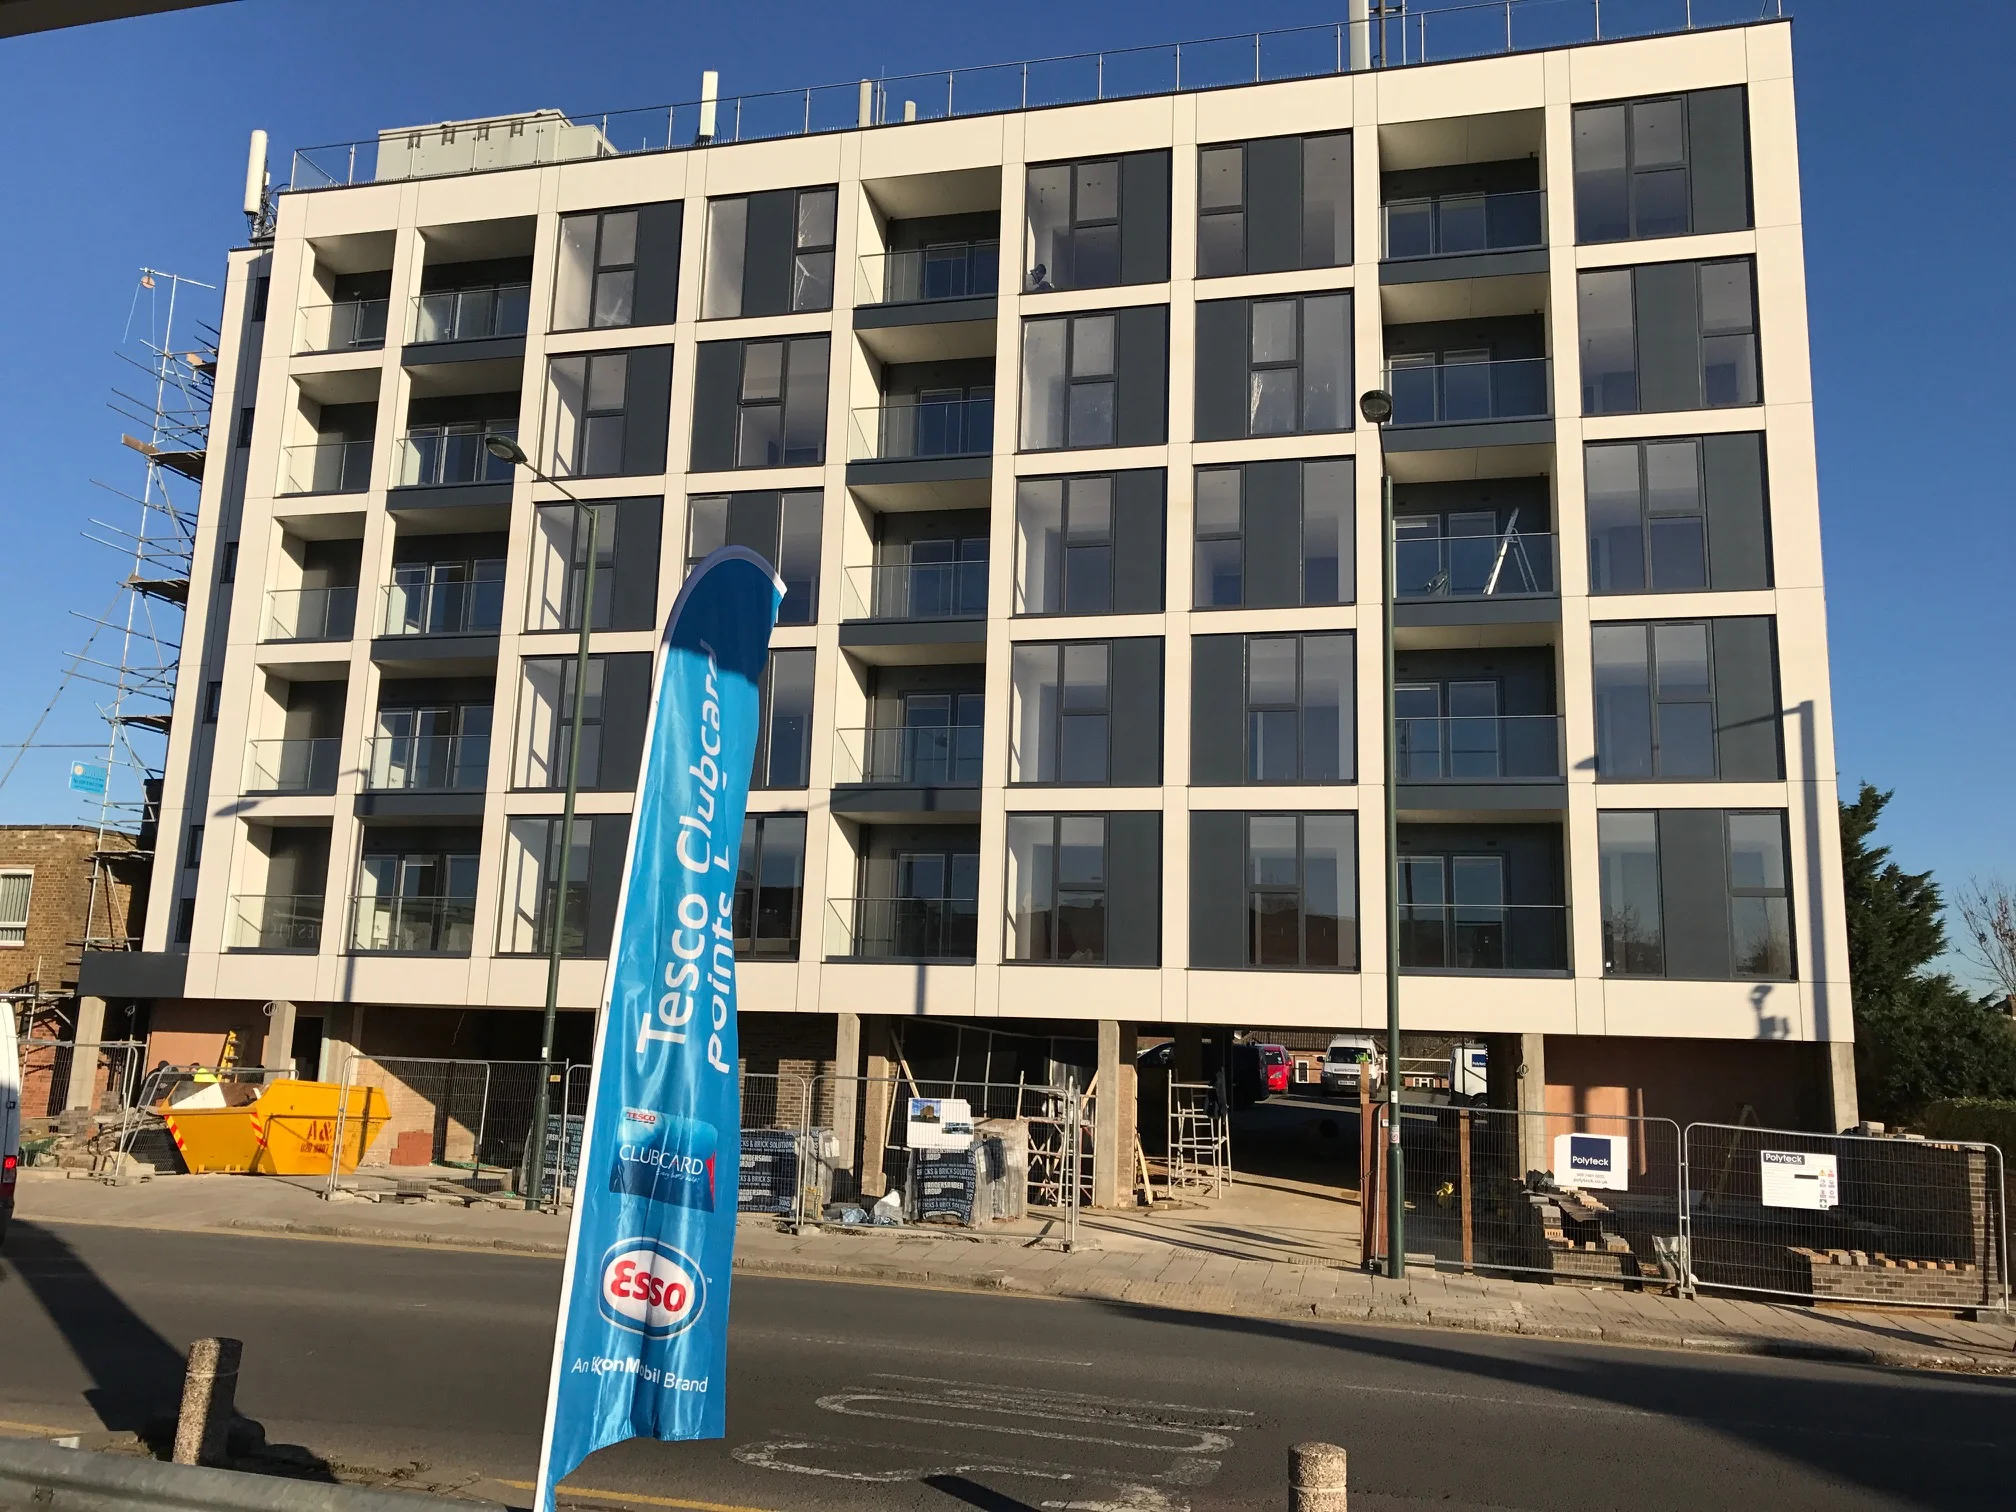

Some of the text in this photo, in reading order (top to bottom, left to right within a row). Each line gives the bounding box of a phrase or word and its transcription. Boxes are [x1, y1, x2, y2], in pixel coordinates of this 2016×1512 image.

[635, 893, 709, 1054] Tesco
[626, 1112, 656, 1122] TESCO
[619, 1144, 704, 1175] CLUBCARD
[1572, 1156, 1610, 1167] Polyteck
[1766, 1153, 1802, 1163] Polyteck
[571, 1357, 589, 1374] An
[663, 1372, 709, 1393] Brand
